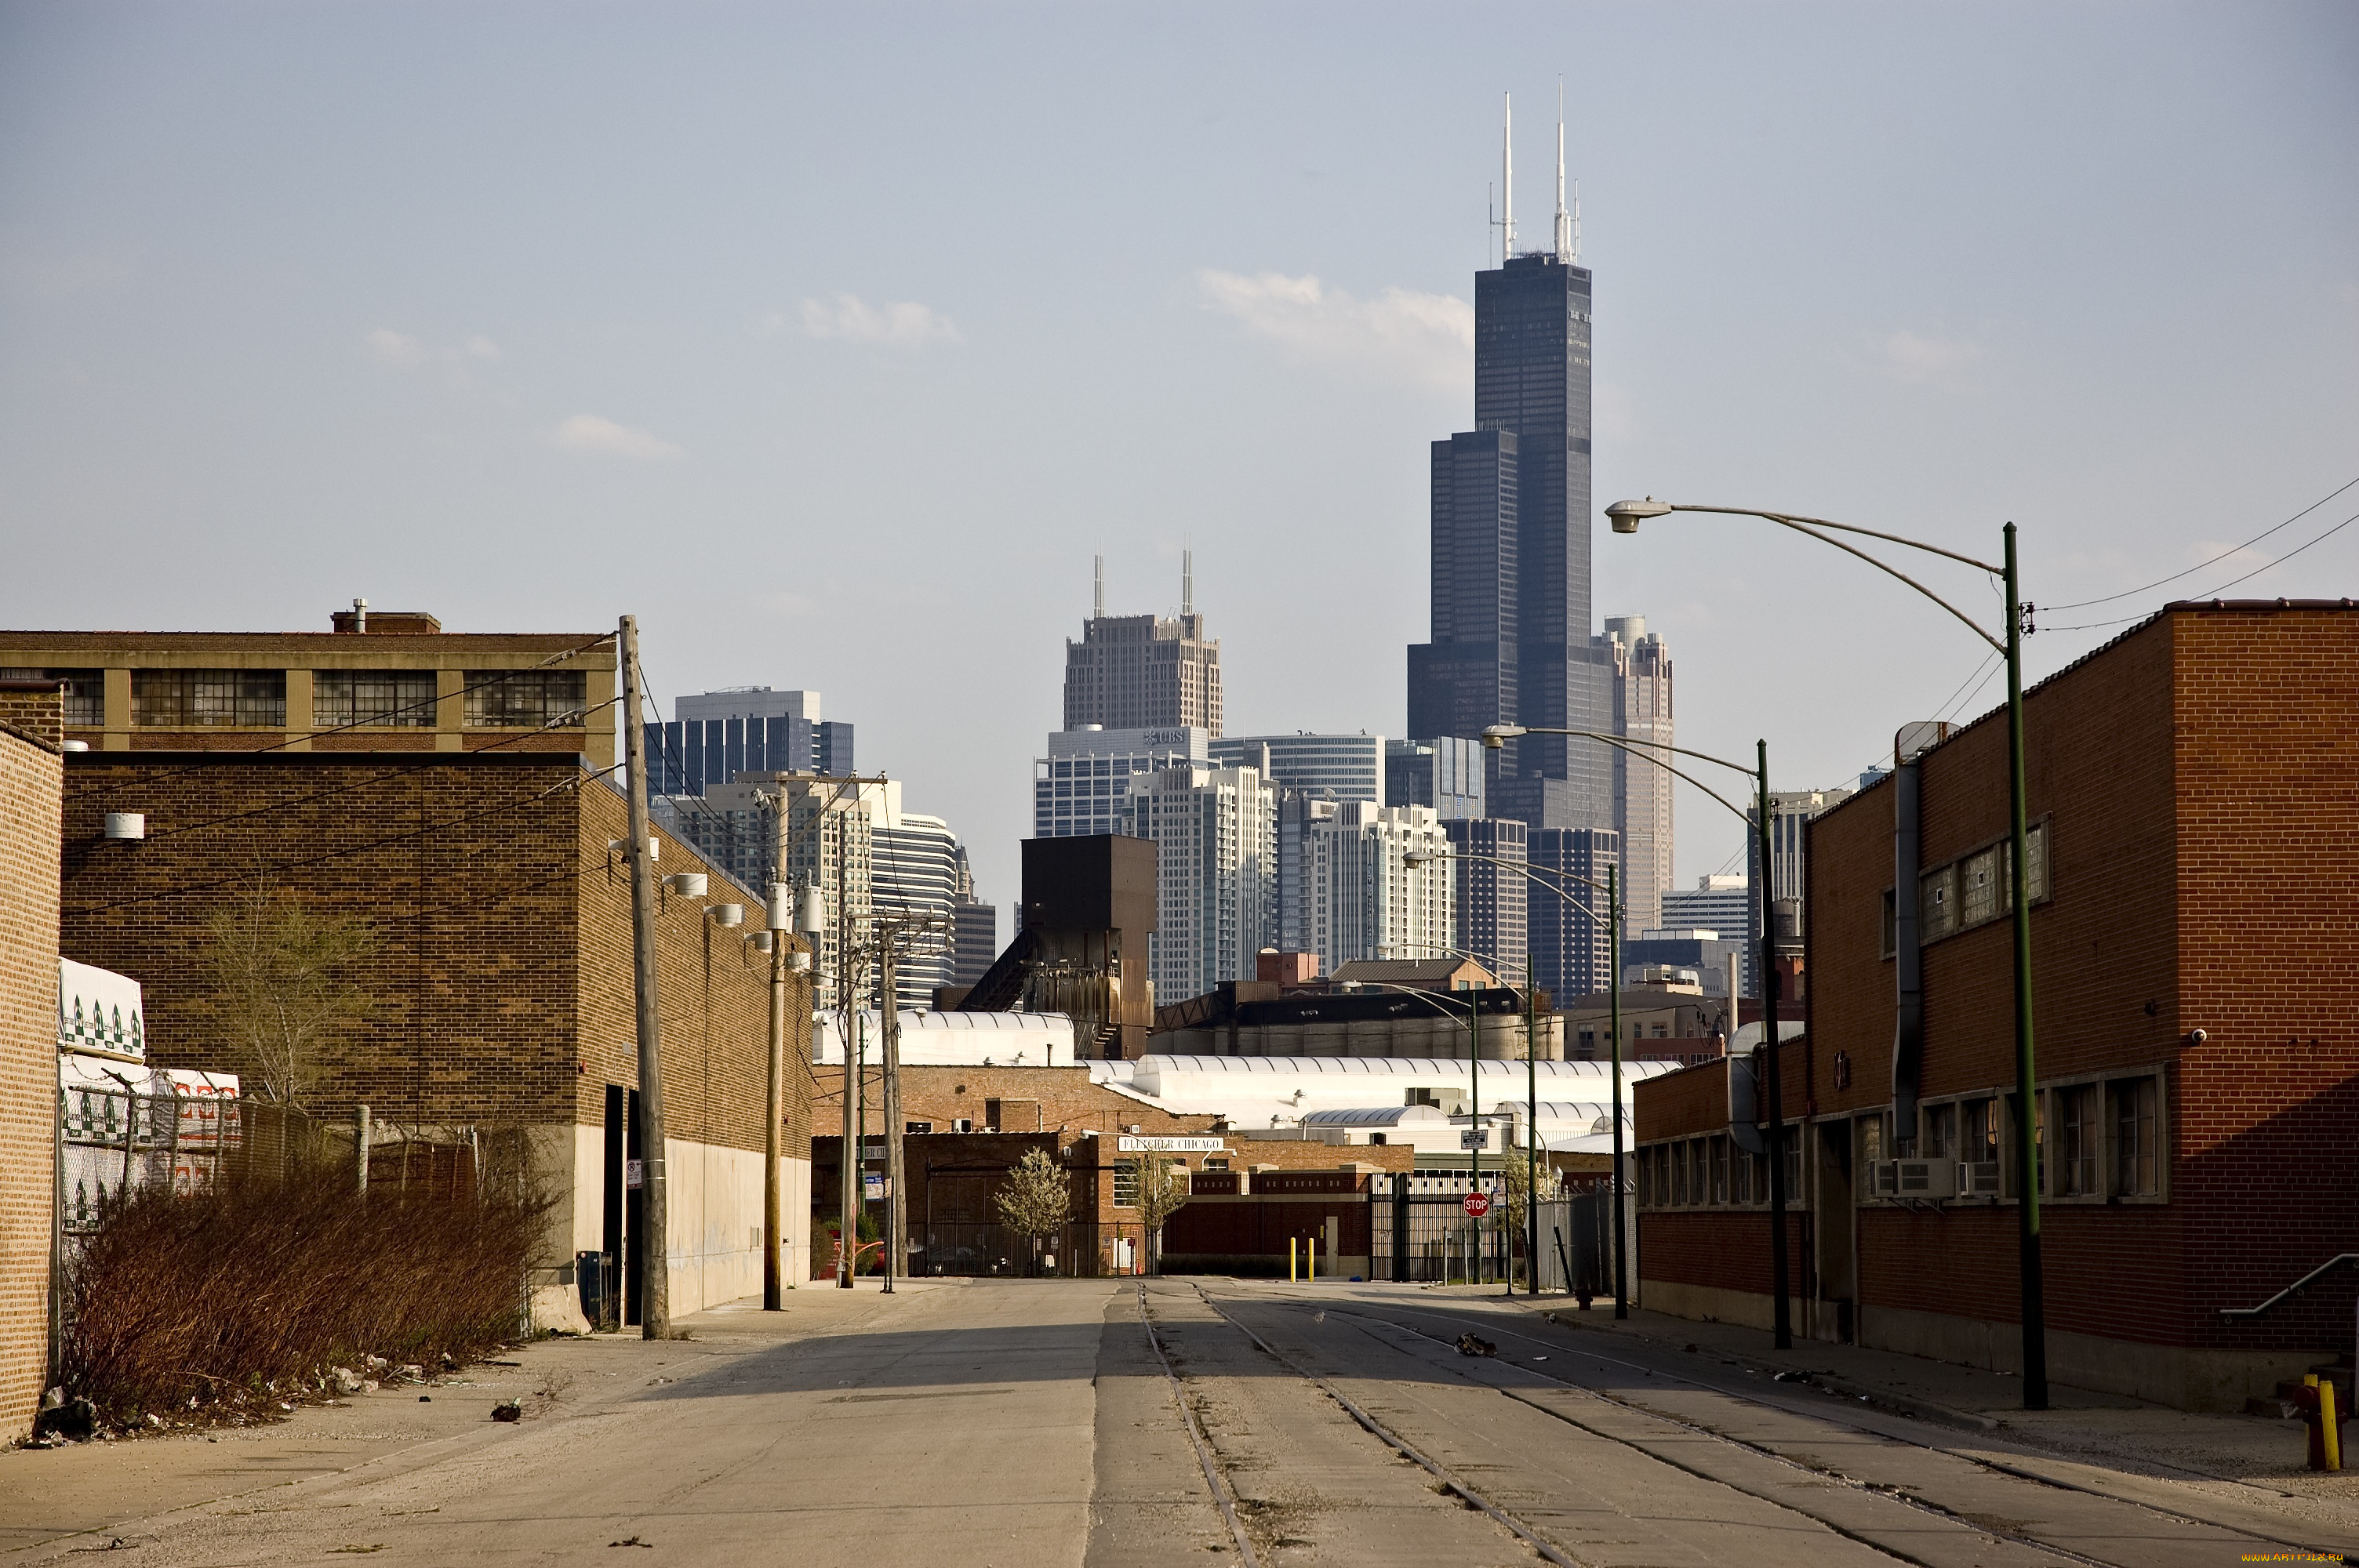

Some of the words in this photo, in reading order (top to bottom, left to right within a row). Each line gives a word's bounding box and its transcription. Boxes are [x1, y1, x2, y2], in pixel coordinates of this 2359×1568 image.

[1159, 731, 1183, 743] UBS
[1124, 1139, 1173, 1149] FLETCHER
[1178, 1139, 1219, 1149] CHICAGO
[1465, 1200, 1487, 1210] STOP
